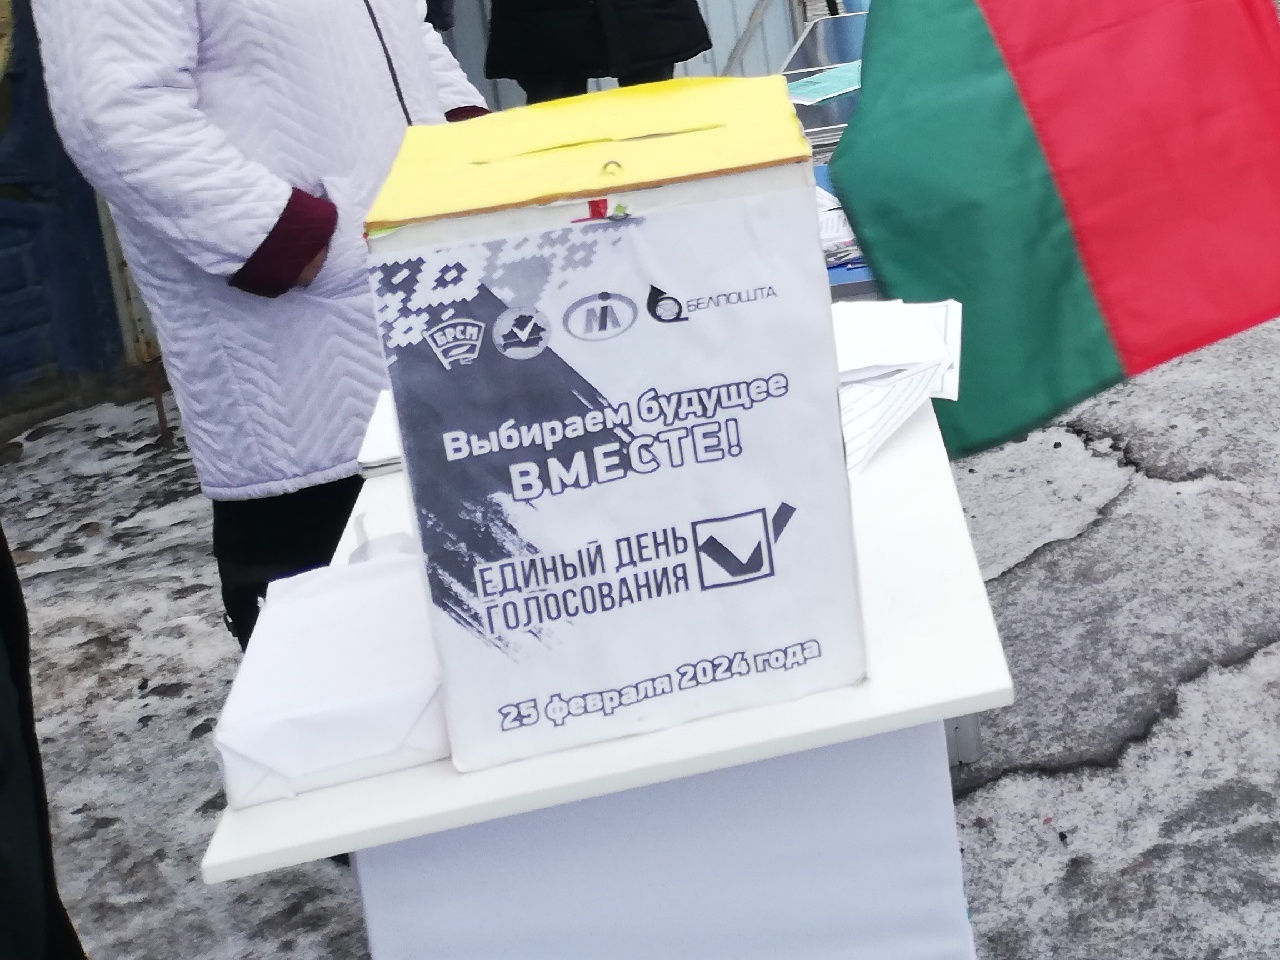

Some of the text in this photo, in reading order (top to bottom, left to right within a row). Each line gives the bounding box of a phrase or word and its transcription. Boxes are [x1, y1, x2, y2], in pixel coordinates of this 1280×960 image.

[686, 286, 778, 313] БЕЛПОШТА
[432, 324, 480, 349] БРСМ
[442, 372, 789, 462] Выбираем будущее
[508, 417, 743, 502] ВМЕСТЕ!
[478, 526, 689, 598] ЕДИНЫЙ ДЕНЬ
[485, 562, 690, 635] ГОЛОСОВАНИЯ
[498, 639, 822, 732] 25 февраля 2024 года
